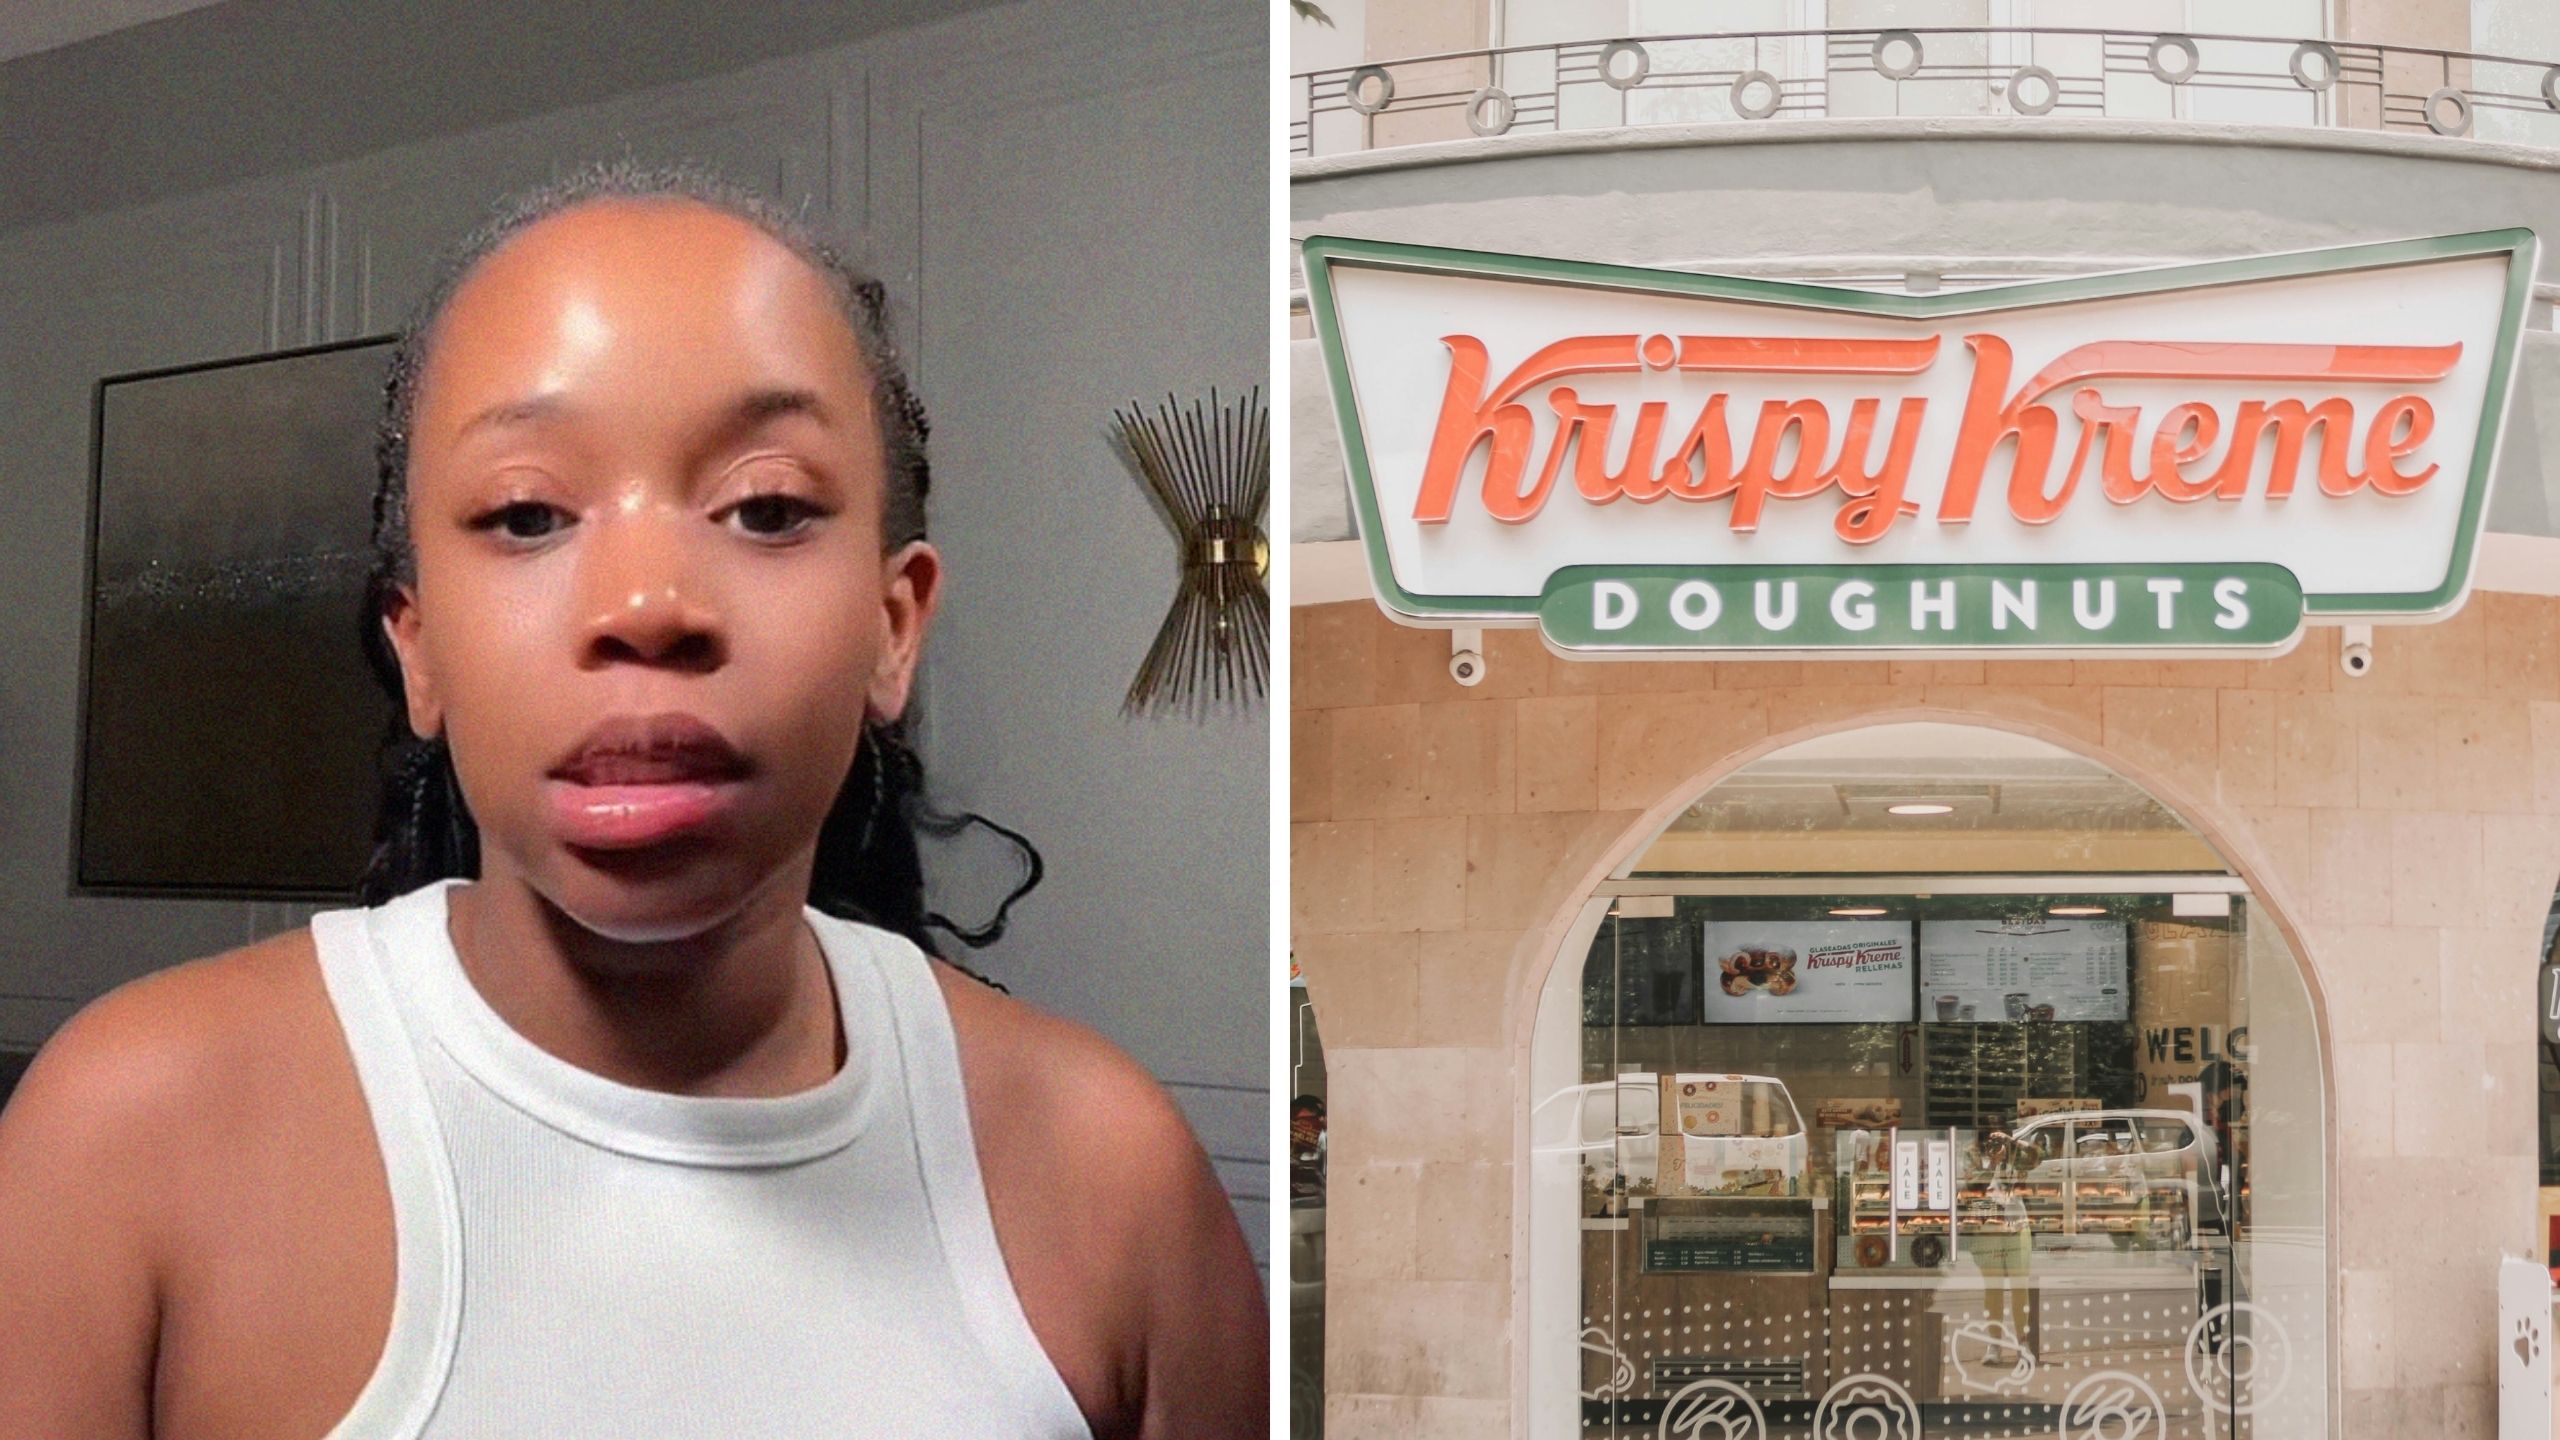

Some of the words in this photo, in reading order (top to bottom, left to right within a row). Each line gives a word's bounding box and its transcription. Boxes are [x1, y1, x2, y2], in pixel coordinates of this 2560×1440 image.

[1411, 333, 1941, 545] Krispy
[1937, 332, 2464, 527] Kreme
[1592, 579, 2251, 632] DOUGHNUTS
[1807, 950, 1855, 969] Krispy
[1855, 946, 1902, 965] Kreme
[1809, 944, 1851, 953] GLASEADAS
[1852, 939, 1896, 949] ORIGINALES
[1855, 962, 1903, 972] RELLENAS
